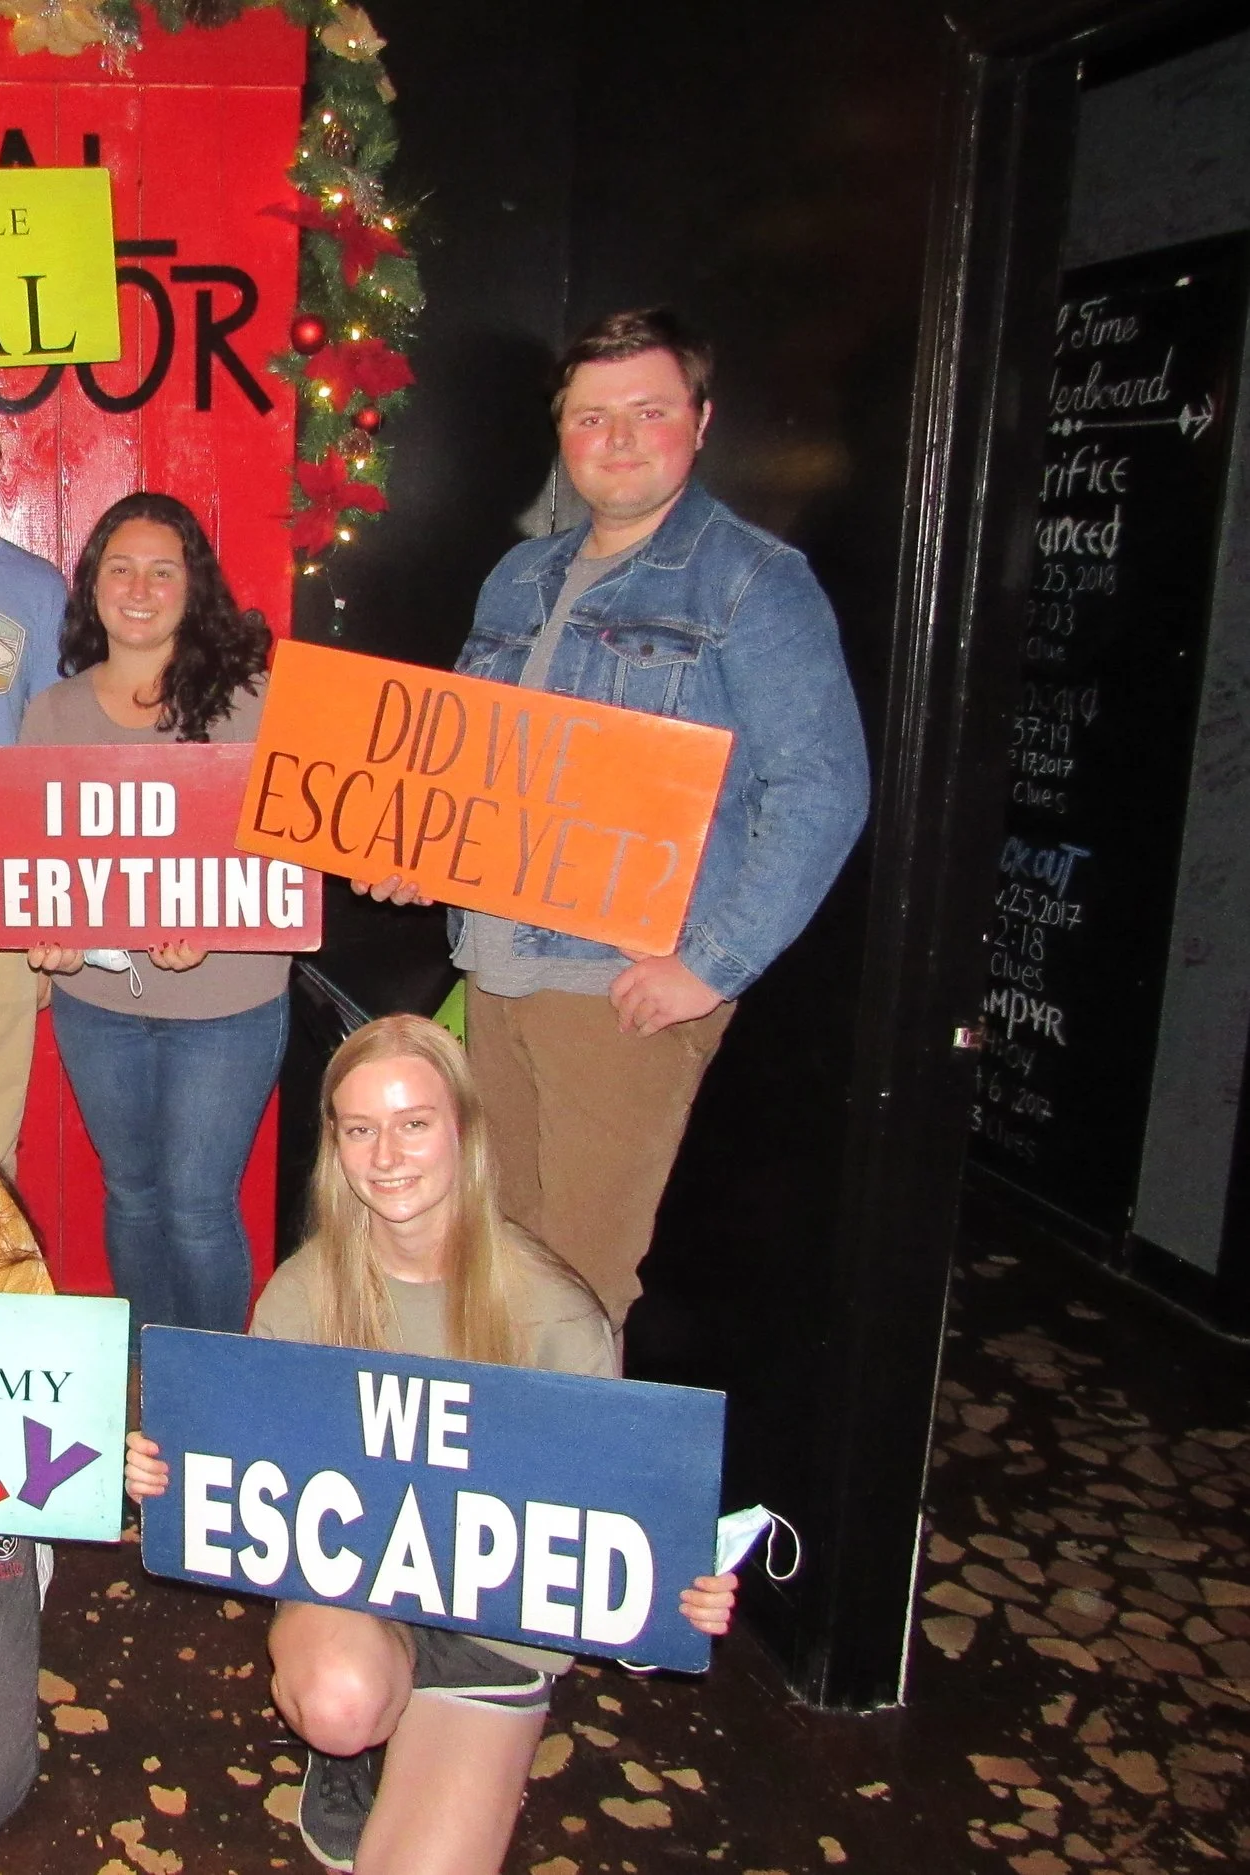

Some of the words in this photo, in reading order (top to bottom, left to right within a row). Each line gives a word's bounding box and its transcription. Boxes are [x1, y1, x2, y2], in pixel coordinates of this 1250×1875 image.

[1071, 295, 1139, 349] Time
[365, 678, 467, 776] DID
[484, 701, 600, 809] WE
[45, 781, 62, 836] I
[78, 781, 177, 837] DID
[253, 751, 500, 887] ESCAPE
[512, 807, 681, 927] YET?
[357, 1370, 471, 1469] WE
[184, 1452, 654, 1645] ESCAPED
